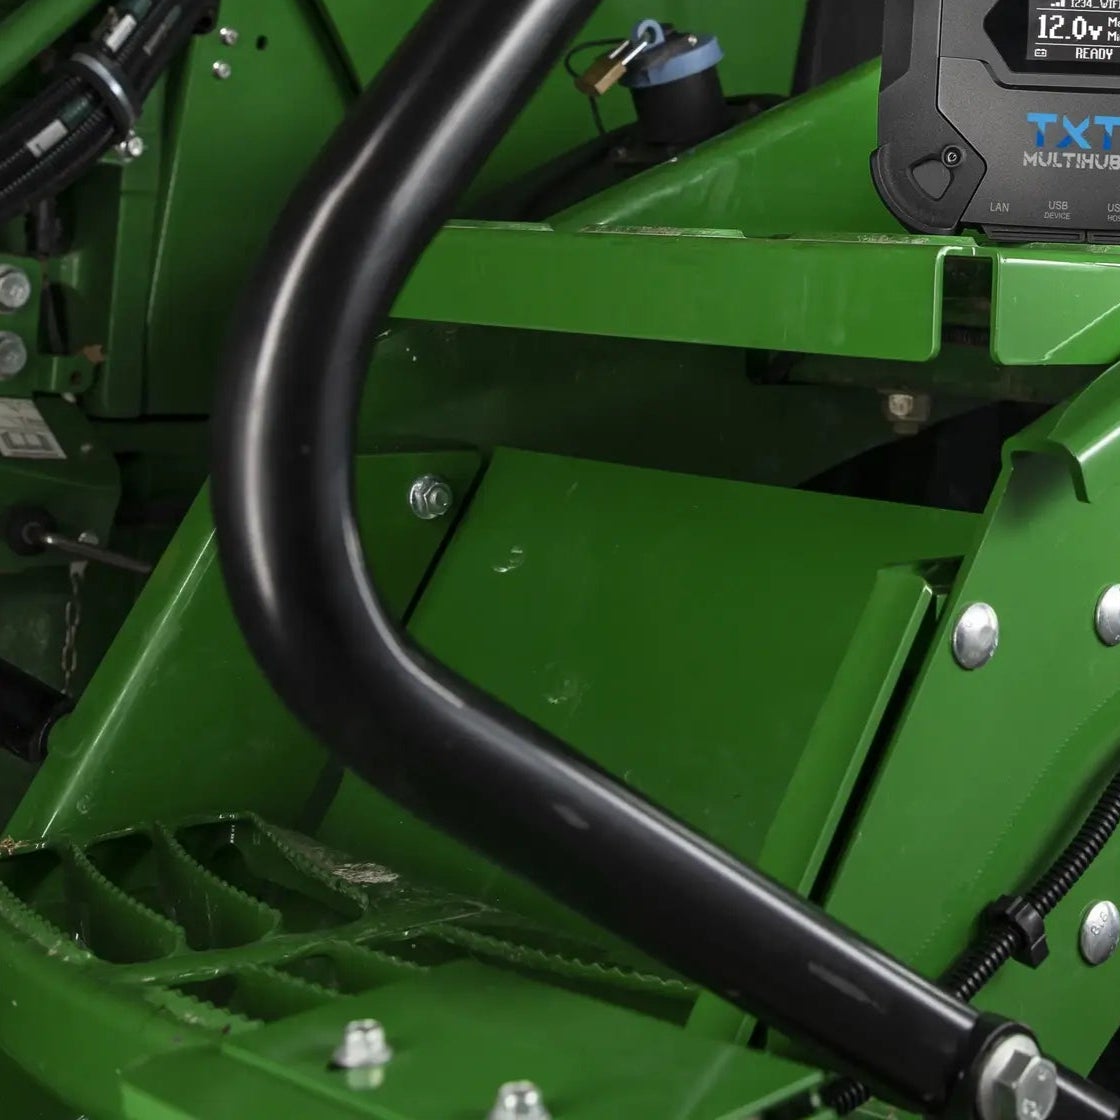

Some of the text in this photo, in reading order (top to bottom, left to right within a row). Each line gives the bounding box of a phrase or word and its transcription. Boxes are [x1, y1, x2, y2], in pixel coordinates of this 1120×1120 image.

[1075, 47, 1114, 60] READY
[989, 201, 1010, 212] LAN
[1048, 200, 1069, 210] USB
[1044, 211, 1072, 220] DEVICE
